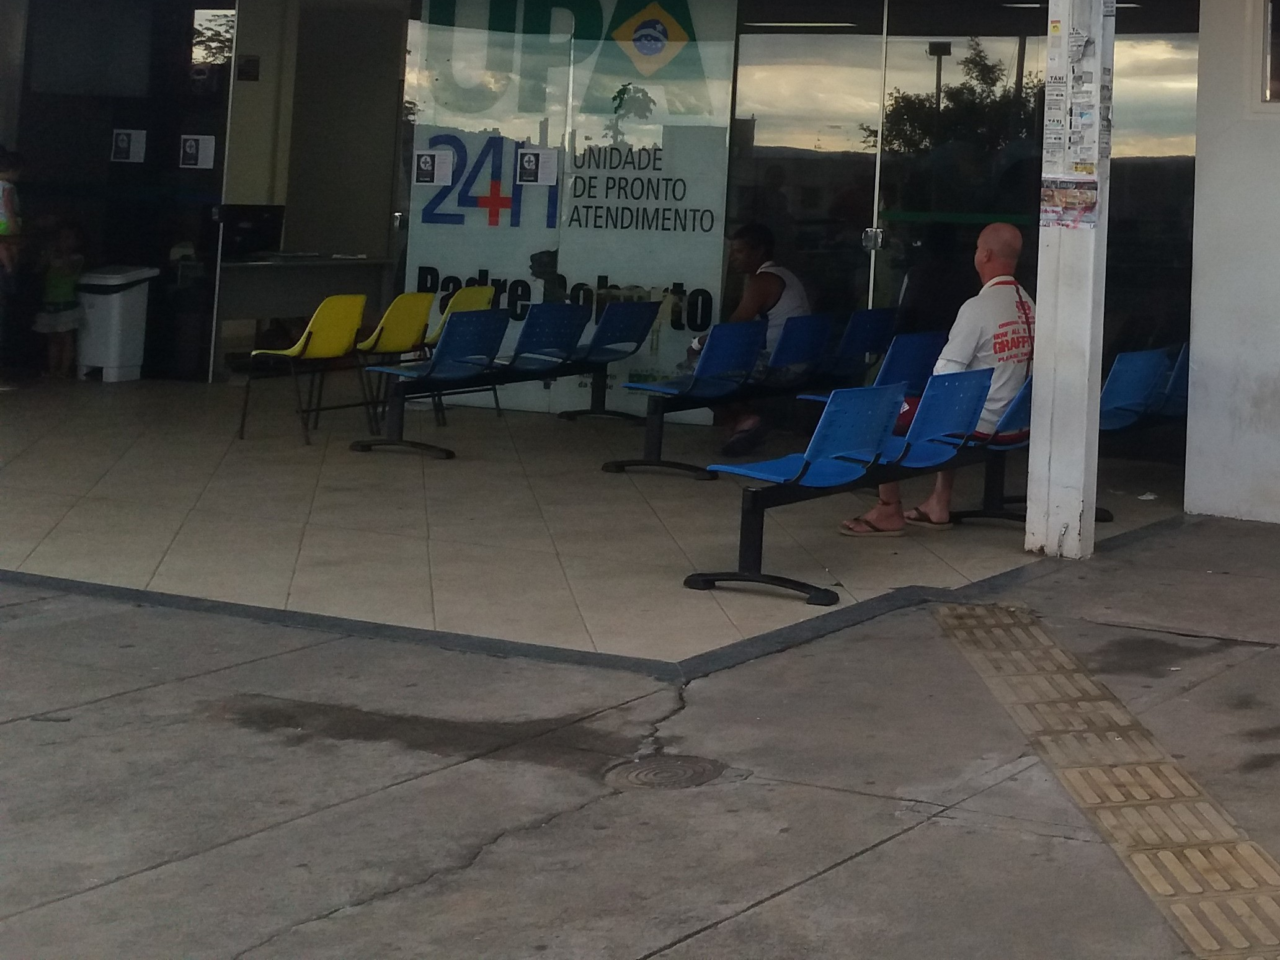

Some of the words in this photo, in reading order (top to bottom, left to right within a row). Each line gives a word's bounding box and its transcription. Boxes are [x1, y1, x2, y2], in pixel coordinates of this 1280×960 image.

[573, 147, 663, 171] UNIDADE
[573, 176, 598, 199] DE
[605, 176, 687, 201] PRONTO
[568, 205, 715, 233] ATENDIMENTO
